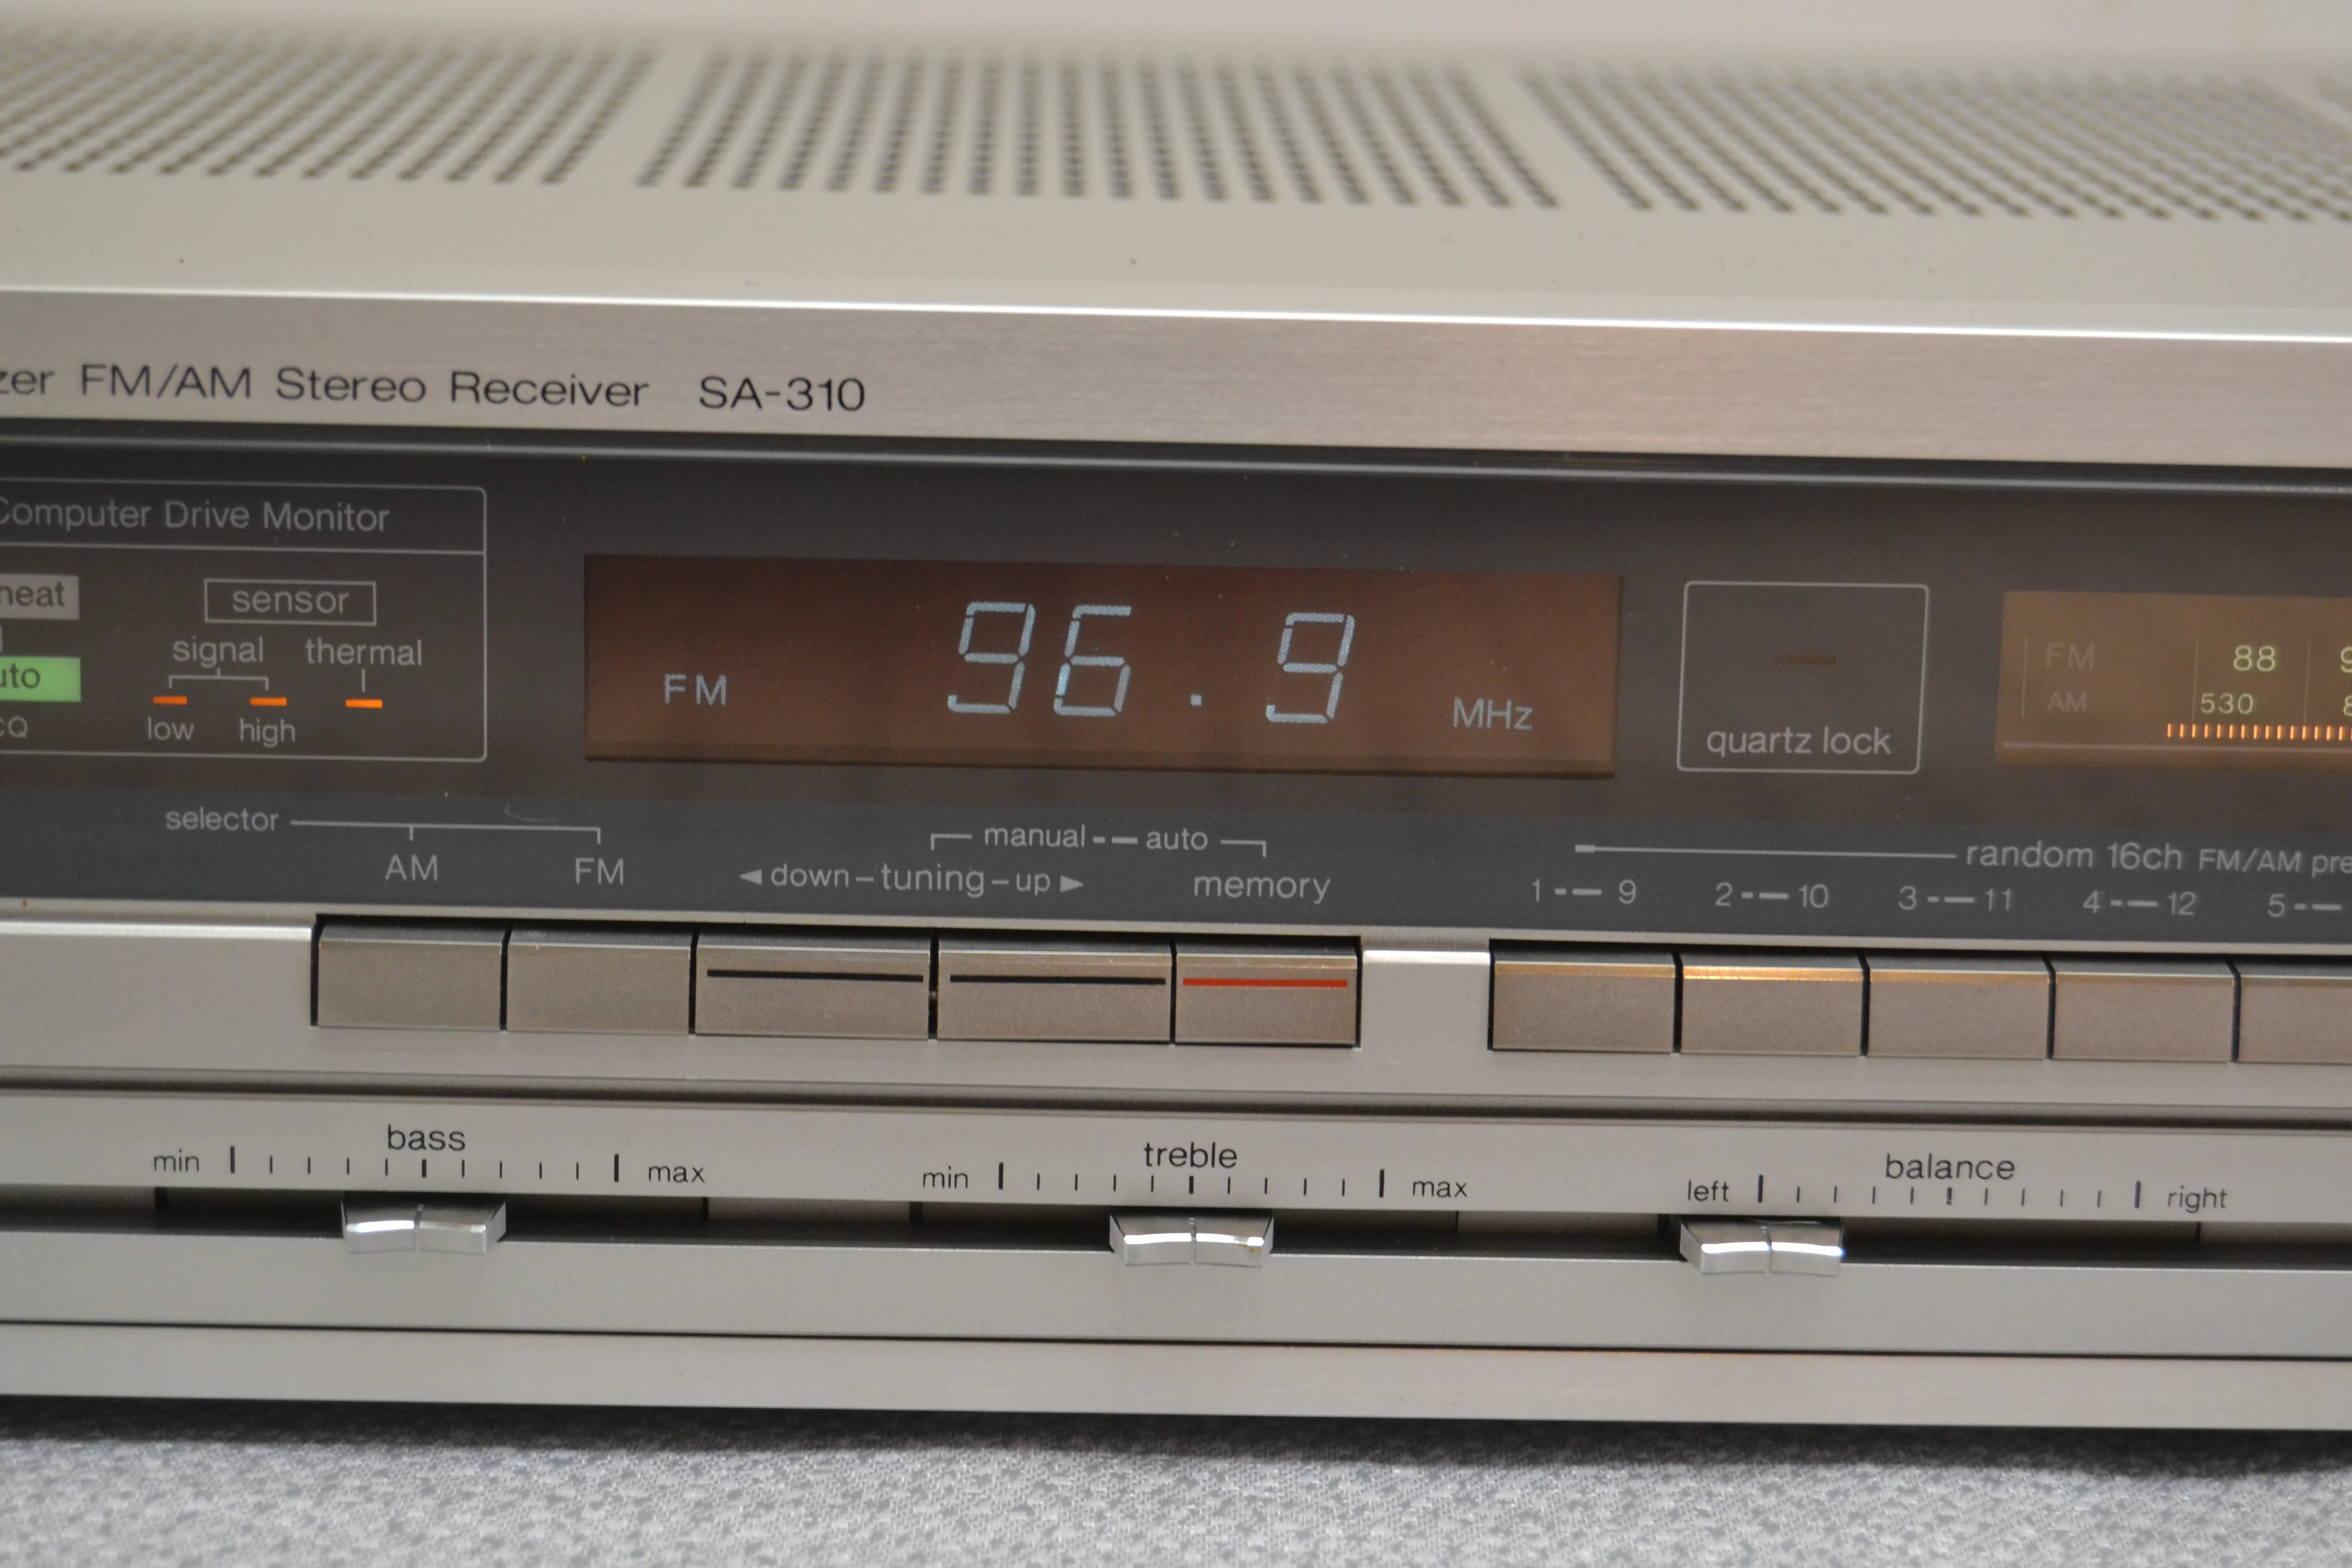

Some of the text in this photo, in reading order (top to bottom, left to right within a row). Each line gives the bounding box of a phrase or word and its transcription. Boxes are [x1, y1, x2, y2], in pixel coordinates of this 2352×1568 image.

[81, 363, 251, 398] FM/AM
[276, 366, 427, 402] Stereo
[451, 370, 649, 407] Receiver
[699, 375, 865, 411] SA-310
[165, 501, 250, 529] Drive
[263, 502, 389, 532] Monitor
[233, 591, 349, 614] sensor
[173, 636, 263, 668] signal
[305, 638, 422, 666] thermal
[2046, 643, 2094, 669] FM
[2233, 645, 2276, 672] 88
[664, 674, 727, 705] FM
[1453, 697, 1533, 730] MHz
[2048, 692, 2087, 710] AM
[2201, 693, 2254, 715] 530
[147, 716, 195, 741] low
[239, 718, 296, 748] high
[1706, 726, 1891, 757] quartz lock
[166, 806, 279, 831] selector
[984, 824, 1208, 851] manual auto
[385, 854, 438, 880] AM
[575, 857, 624, 884] FM
[1967, 840, 2352, 877] random 16ch FM/AM pre
[1194, 875, 1331, 904] memory
[1532, 879, 1637, 904] 1 9
[1715, 881, 1829, 909] 2 10
[1899, 885, 2012, 911] 3 11
[2082, 890, 2196, 916] 4 12
[2268, 893, 2286, 918] 5
[387, 1124, 466, 1152] bass
[153, 1148, 200, 1172] min
[1144, 1142, 1238, 1169] treble
[1885, 1153, 2016, 1181] balance
[648, 1165, 705, 1183] max
[922, 1165, 969, 1189] min
[1412, 1180, 1467, 1198] max
[1687, 1181, 1729, 1202] left
[2167, 1185, 2227, 1214] right
